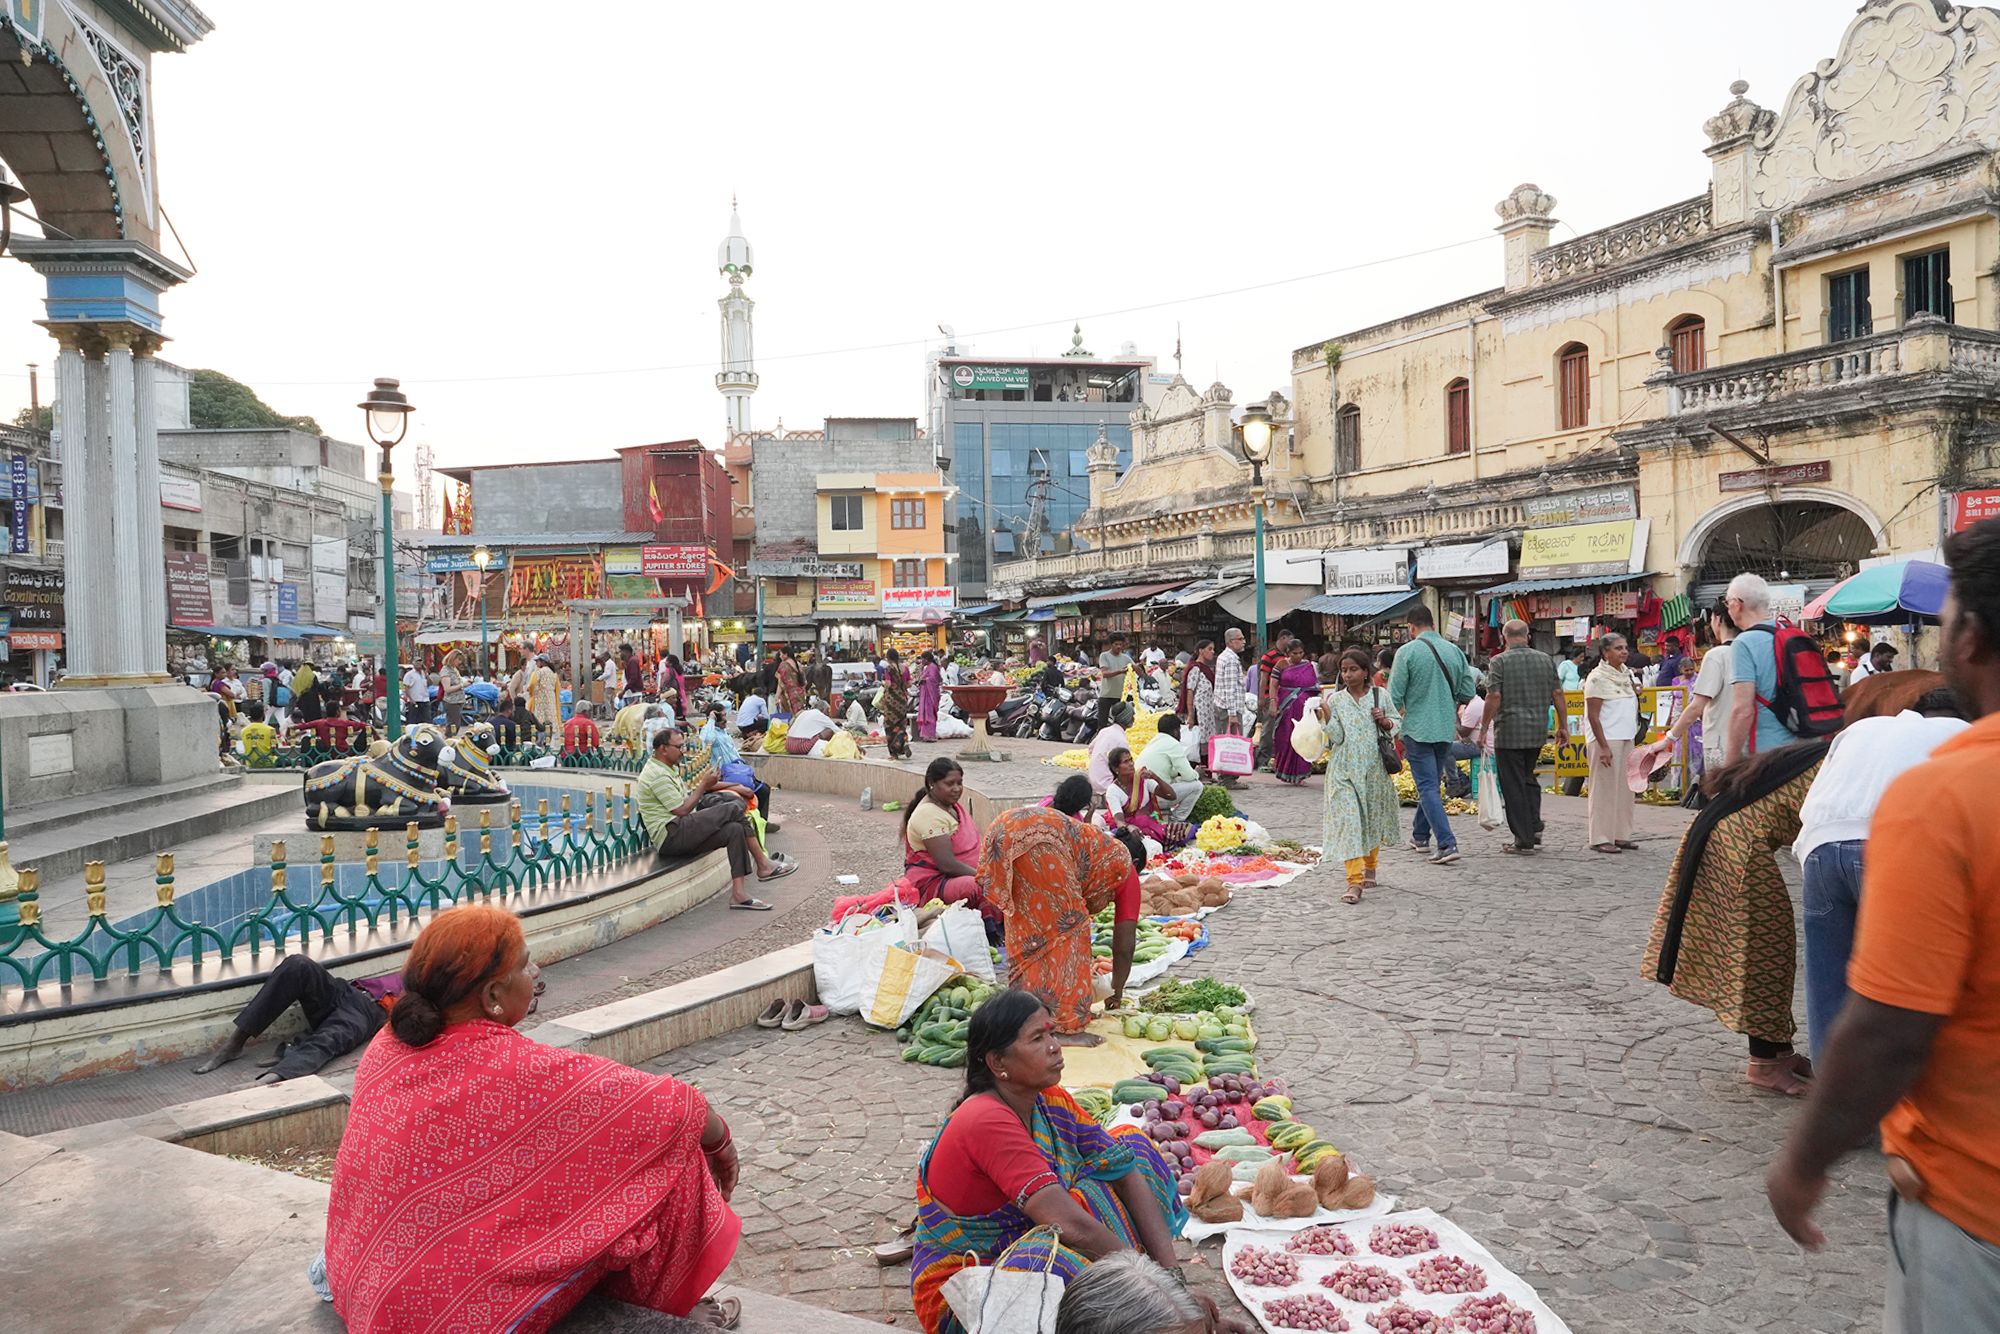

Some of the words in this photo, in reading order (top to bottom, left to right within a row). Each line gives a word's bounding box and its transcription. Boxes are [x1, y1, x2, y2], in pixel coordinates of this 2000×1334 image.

[1966, 496, 1982, 508] ಶ್ರೀ
[1965, 508, 1981, 517] SRI
[1984, 507, 2000, 516] RA
[1587, 532, 1625, 548] TROJAN
[431, 561, 449, 569] New
[450, 560, 479, 569] Jupite
[644, 562, 675, 570] JUPITER
[676, 562, 706, 570] STORES
[1558, 743, 1588, 761] CY
